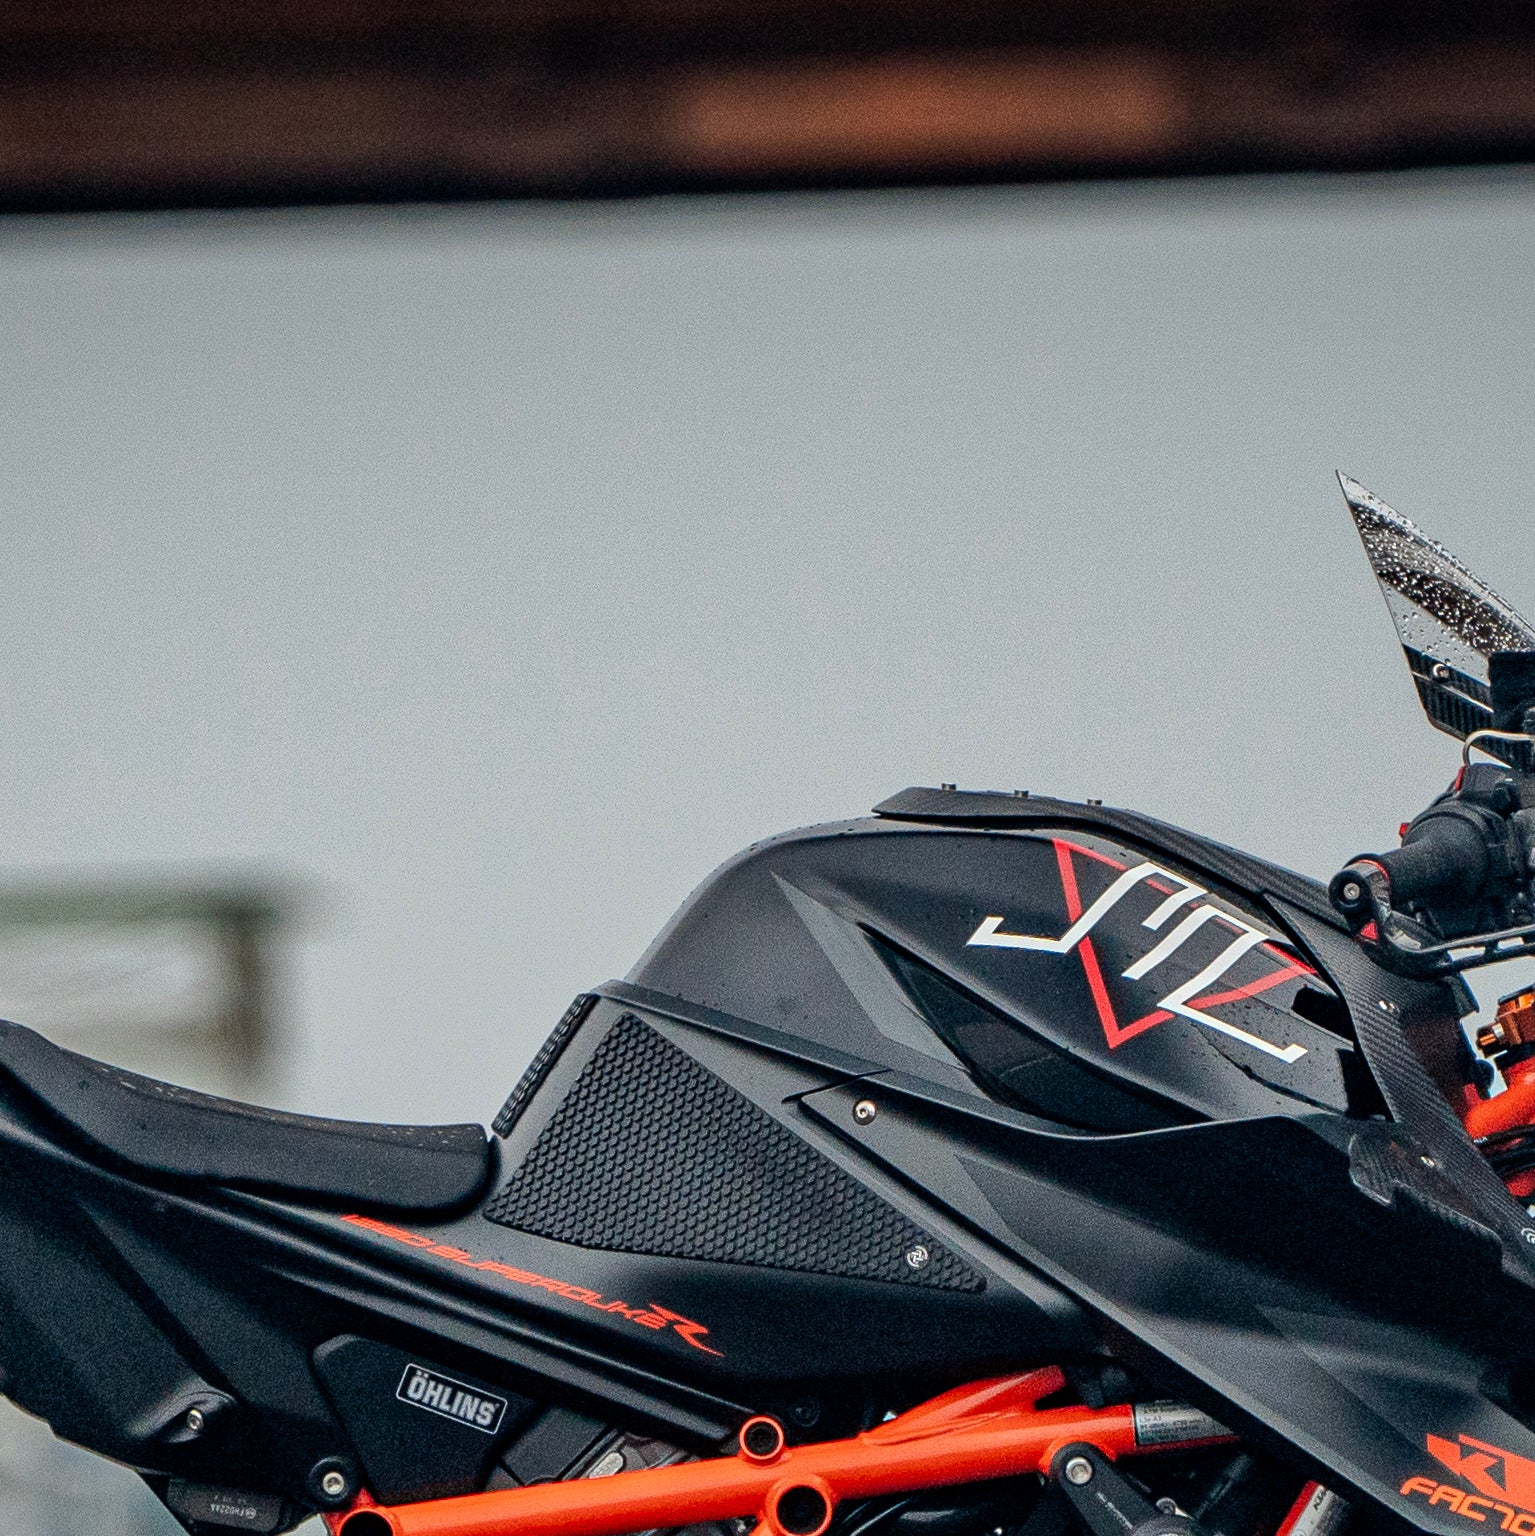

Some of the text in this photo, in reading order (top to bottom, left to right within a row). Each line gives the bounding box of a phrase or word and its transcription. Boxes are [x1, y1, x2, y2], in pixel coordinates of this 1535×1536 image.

[426, 1245, 667, 1330] SUPERDUKE
[650, 1303, 725, 1358] R
[407, 1370, 497, 1426] ÖHLINS
